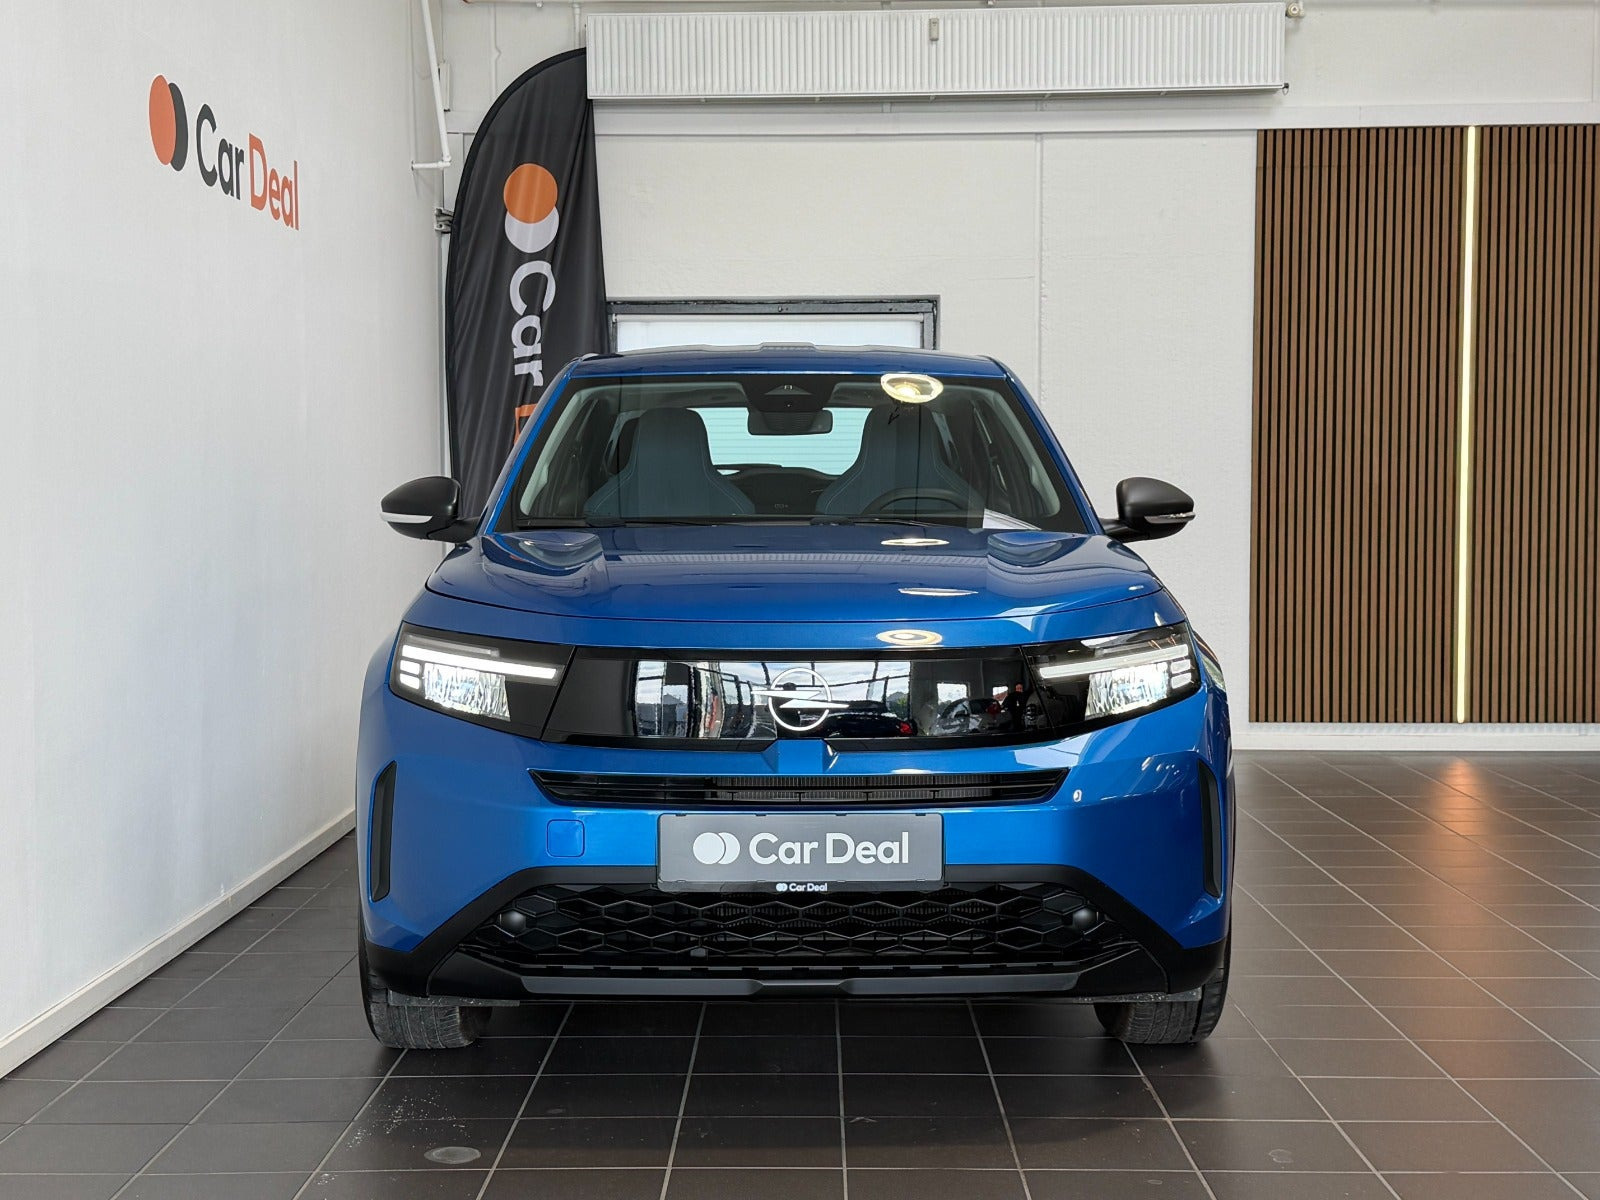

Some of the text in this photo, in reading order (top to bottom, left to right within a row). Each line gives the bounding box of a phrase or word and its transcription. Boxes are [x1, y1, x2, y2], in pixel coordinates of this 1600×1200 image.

[196, 103, 299, 230] Car Deal
[509, 260, 556, 387] Car
[749, 831, 909, 865] Car Deal
[789, 882, 828, 892] Car Deal
